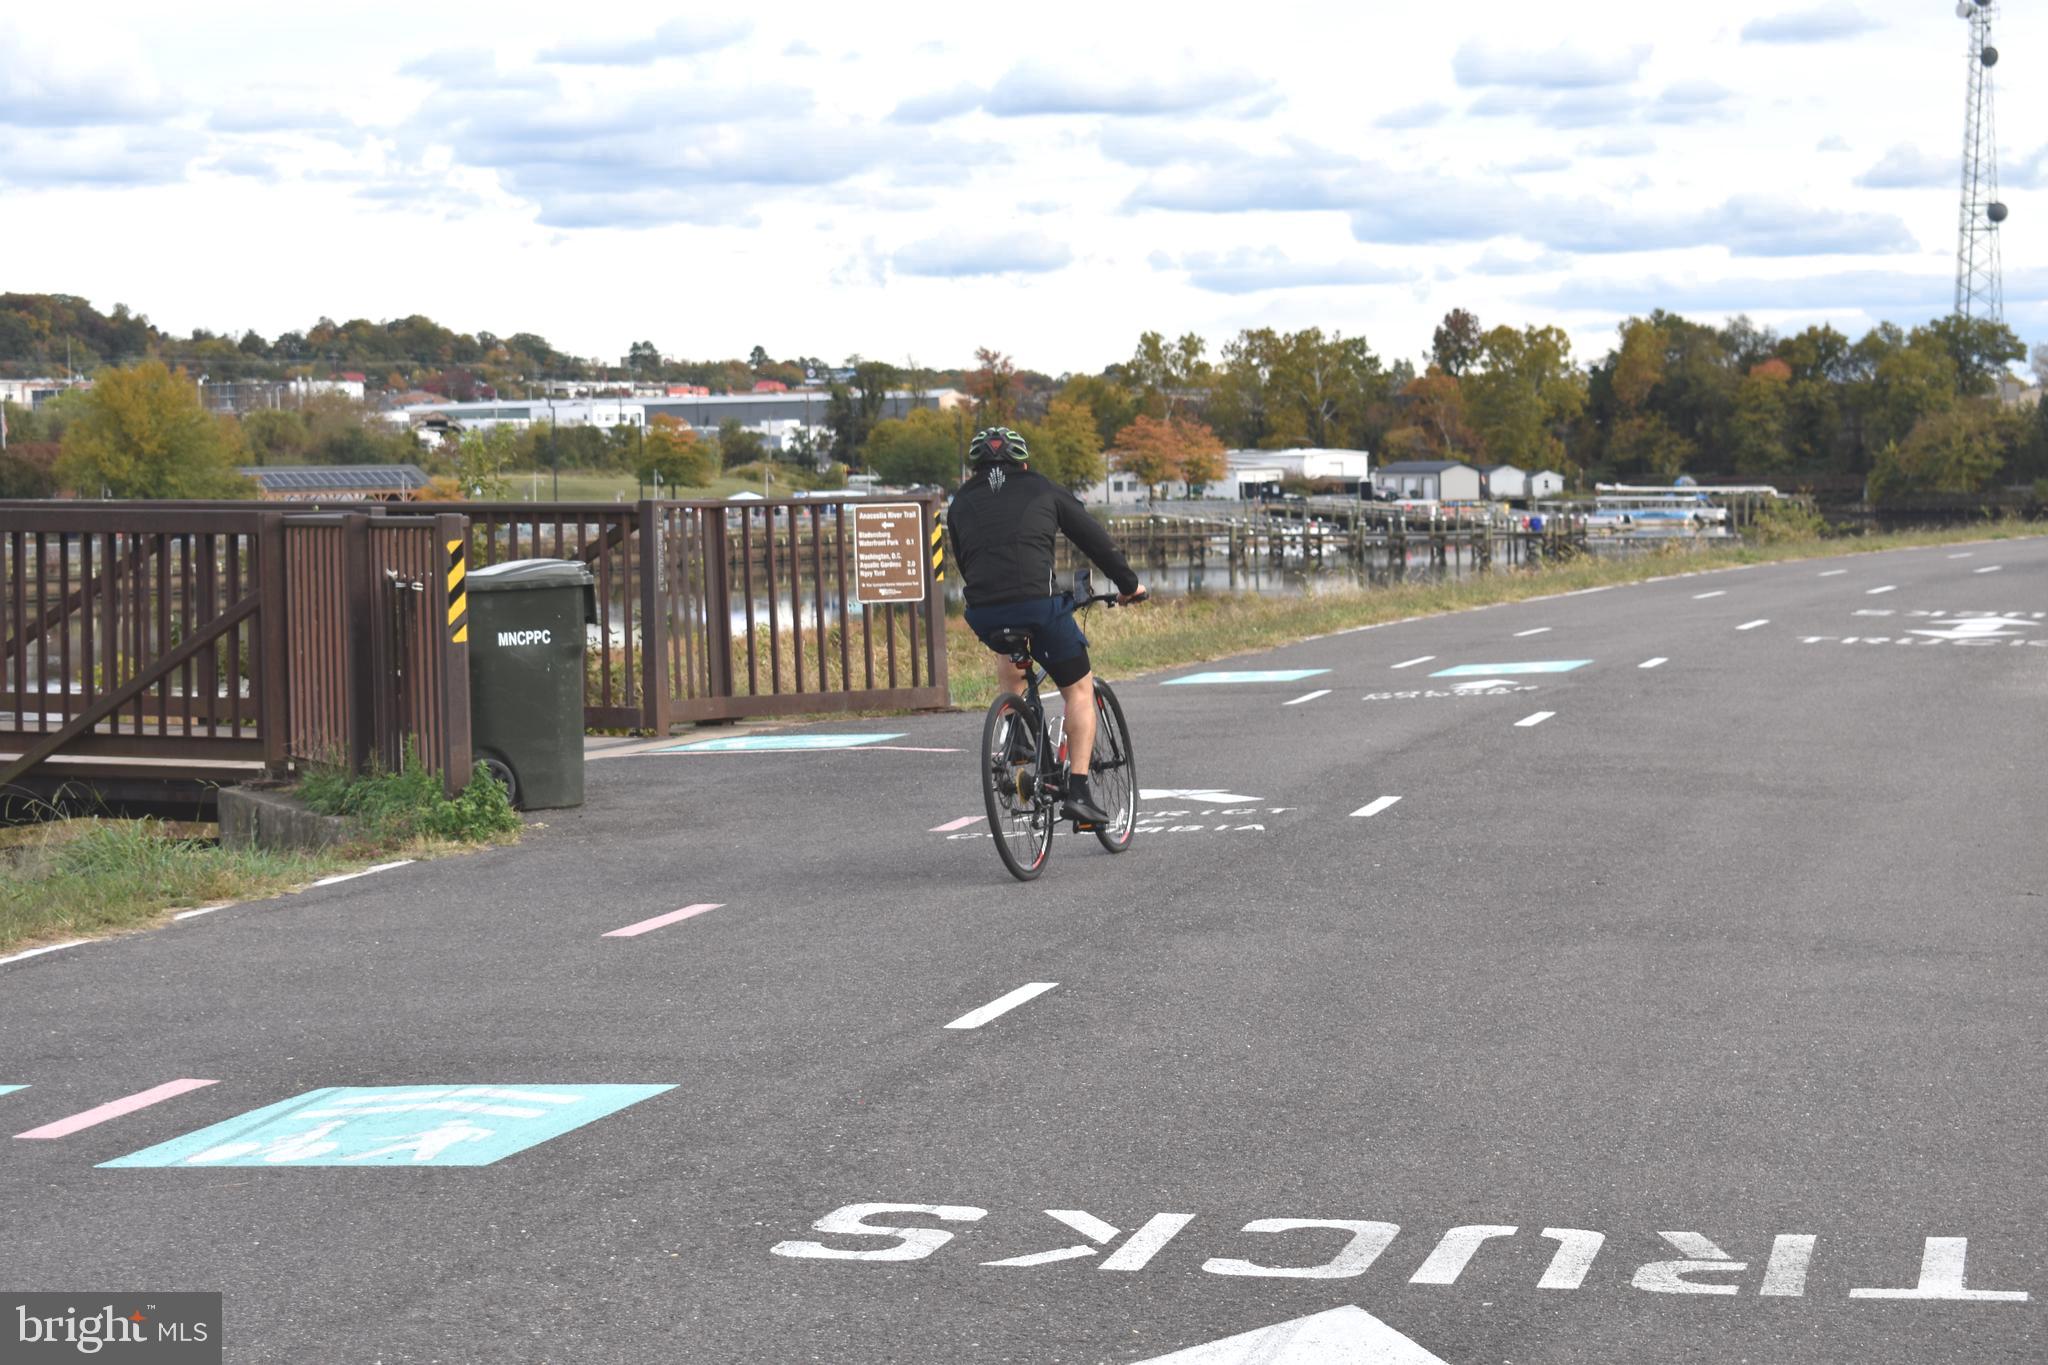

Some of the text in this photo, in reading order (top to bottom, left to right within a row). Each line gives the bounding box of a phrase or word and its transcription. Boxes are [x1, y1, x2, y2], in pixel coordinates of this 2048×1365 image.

[859, 510, 916, 520] Anacostia River Trail
[891, 552, 902, 560] D.C.
[860, 561, 880, 569] Aquatic
[860, 570, 873, 578] Navy
[873, 569, 886, 577] Yard
[497, 629, 551, 647] MNCPPC
[771, 1202, 2029, 1302] TRUCKS
